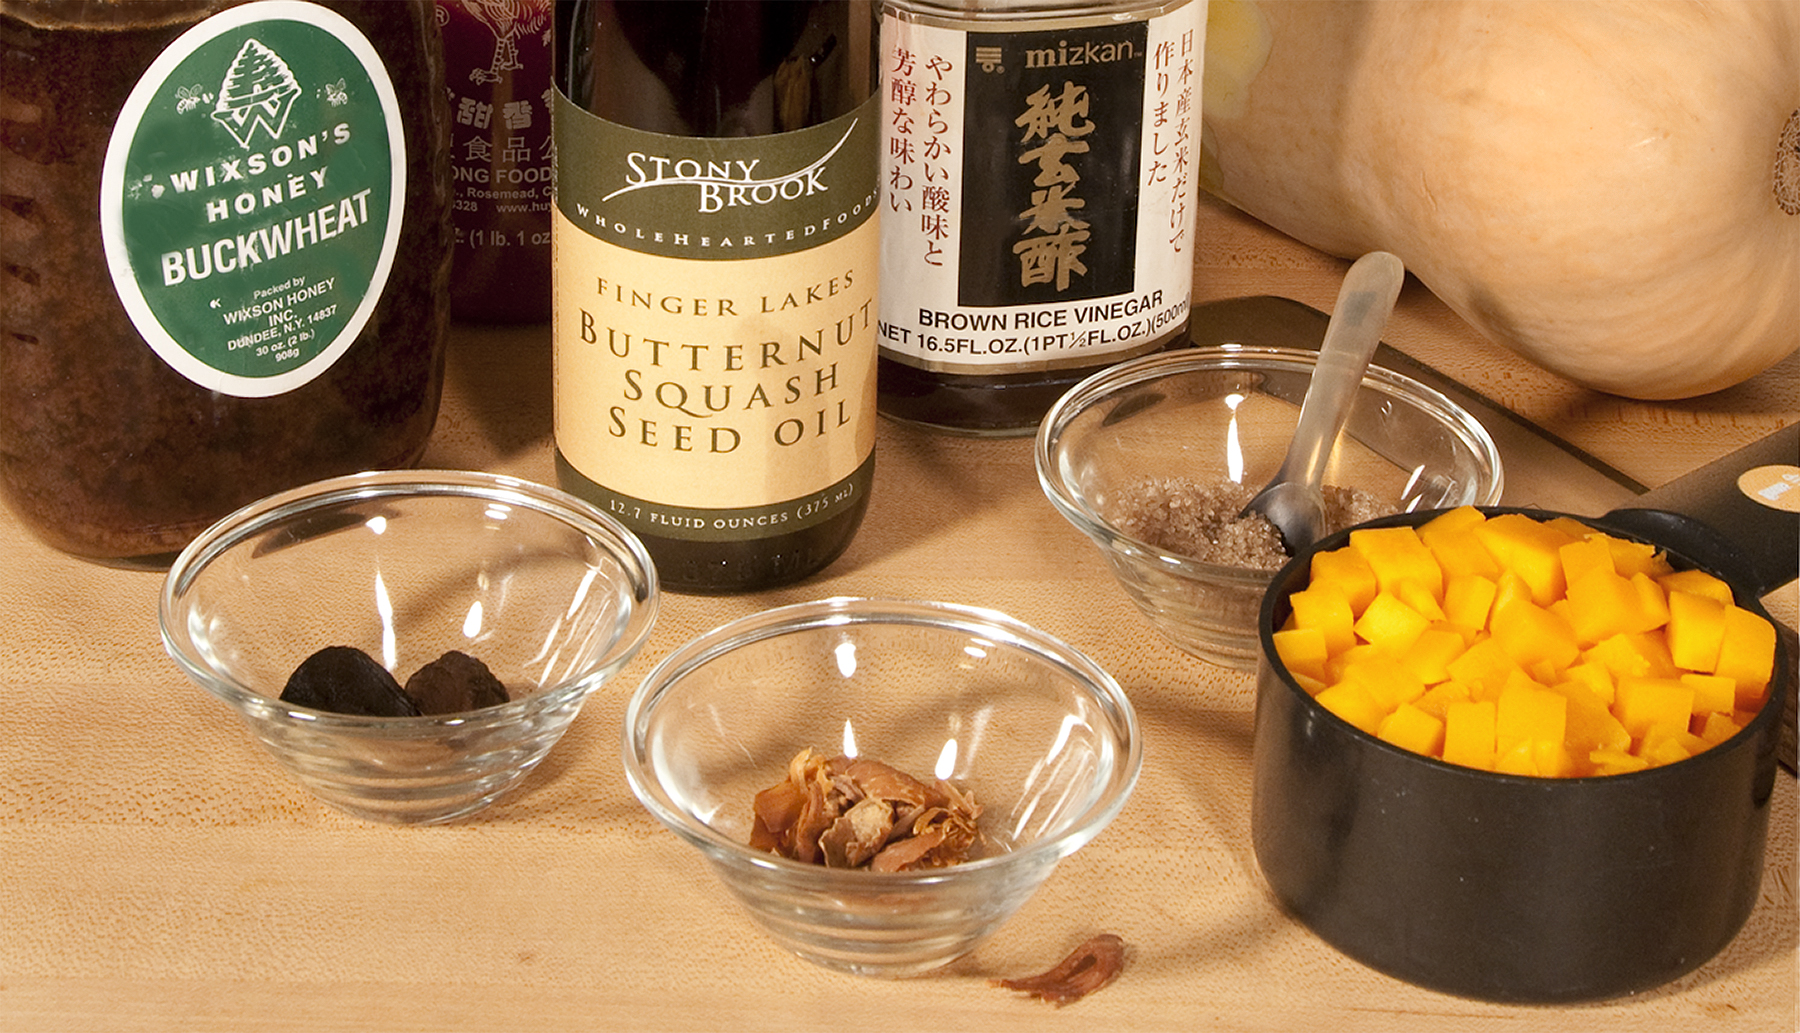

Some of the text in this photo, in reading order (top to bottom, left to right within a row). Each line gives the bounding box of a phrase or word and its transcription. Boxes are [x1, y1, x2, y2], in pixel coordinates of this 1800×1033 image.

[890, 47, 917, 213] 芳醇な味わい
[1148, 41, 1175, 186] 作りました
[170, 123, 350, 193] WIXSON'S
[450, 133, 552, 162] 食品
[921, 55, 953, 267] やわらかい酸味と
[1169, 29, 1194, 253] 日本産玄米だけで
[625, 152, 760, 186] STONY
[698, 167, 828, 213] BROOK
[1012, 81, 1096, 292] 純玄米酢
[206, 166, 329, 222] HONEY
[453, 200, 478, 212] 328
[467, 187, 539, 199] Rosemead,
[161, 188, 371, 286] BUCKWHEAT
[490, 230, 511, 246] lb.
[517, 230, 524, 246] 1
[223, 277, 335, 325] WIXSON HONEY
[253, 276, 305, 300] Packed by
[597, 269, 854, 316] FINGER LAKES
[919, 289, 1163, 331] BROWN RICE VINEGAR
[227, 304, 337, 351] DUNDEE, N.Y. 14837
[268, 309, 298, 327] INC.
[580, 298, 873, 371] BUTTERNUT
[878, 320, 911, 344] NET
[256, 328, 315, 356] 30 oz. (2 lb.)
[275, 348, 300, 362] 908g
[624, 362, 838, 418] SQUASH
[609, 399, 850, 454] SEED OIL
[609, 499, 641, 519] 12.7
[650, 513, 705, 529] FLUID
[713, 512, 788, 529] OUNCES
[797, 497, 829, 519] (375
